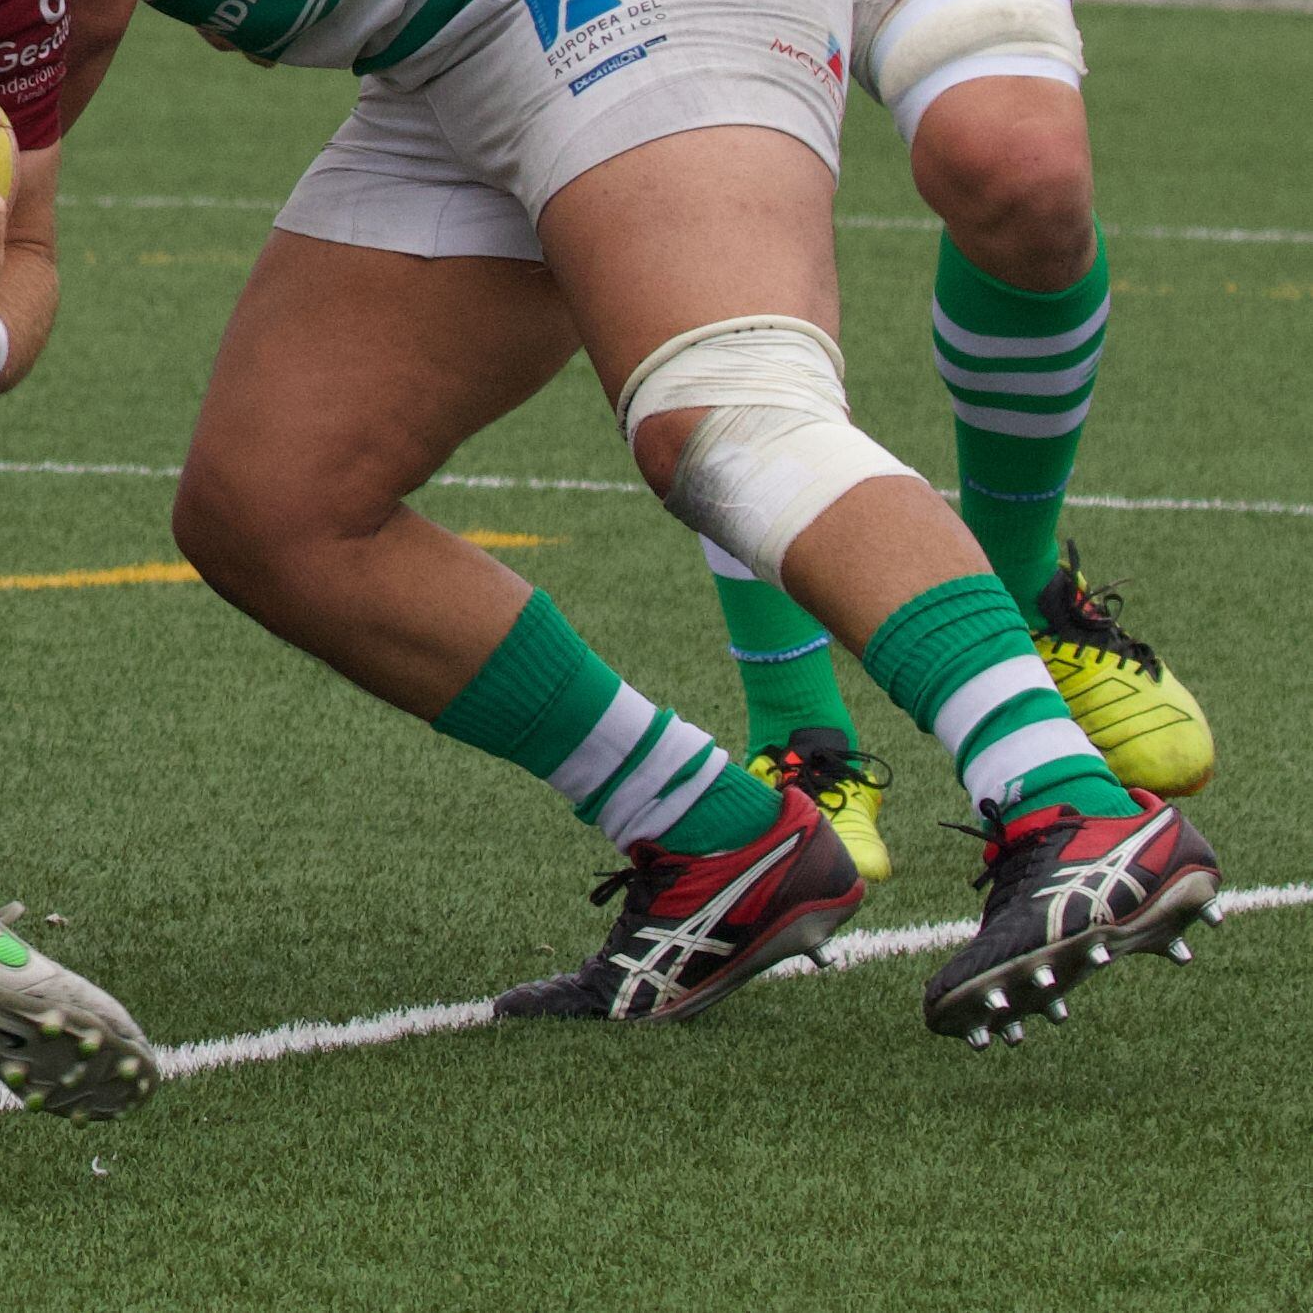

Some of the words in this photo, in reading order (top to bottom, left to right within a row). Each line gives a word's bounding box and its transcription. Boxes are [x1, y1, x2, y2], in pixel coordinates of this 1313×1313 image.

[547, 14, 621, 67] EUROPEA
[554, 12, 667, 80] ATLÁNTICO
[573, 47, 642, 92] DECATHLON
